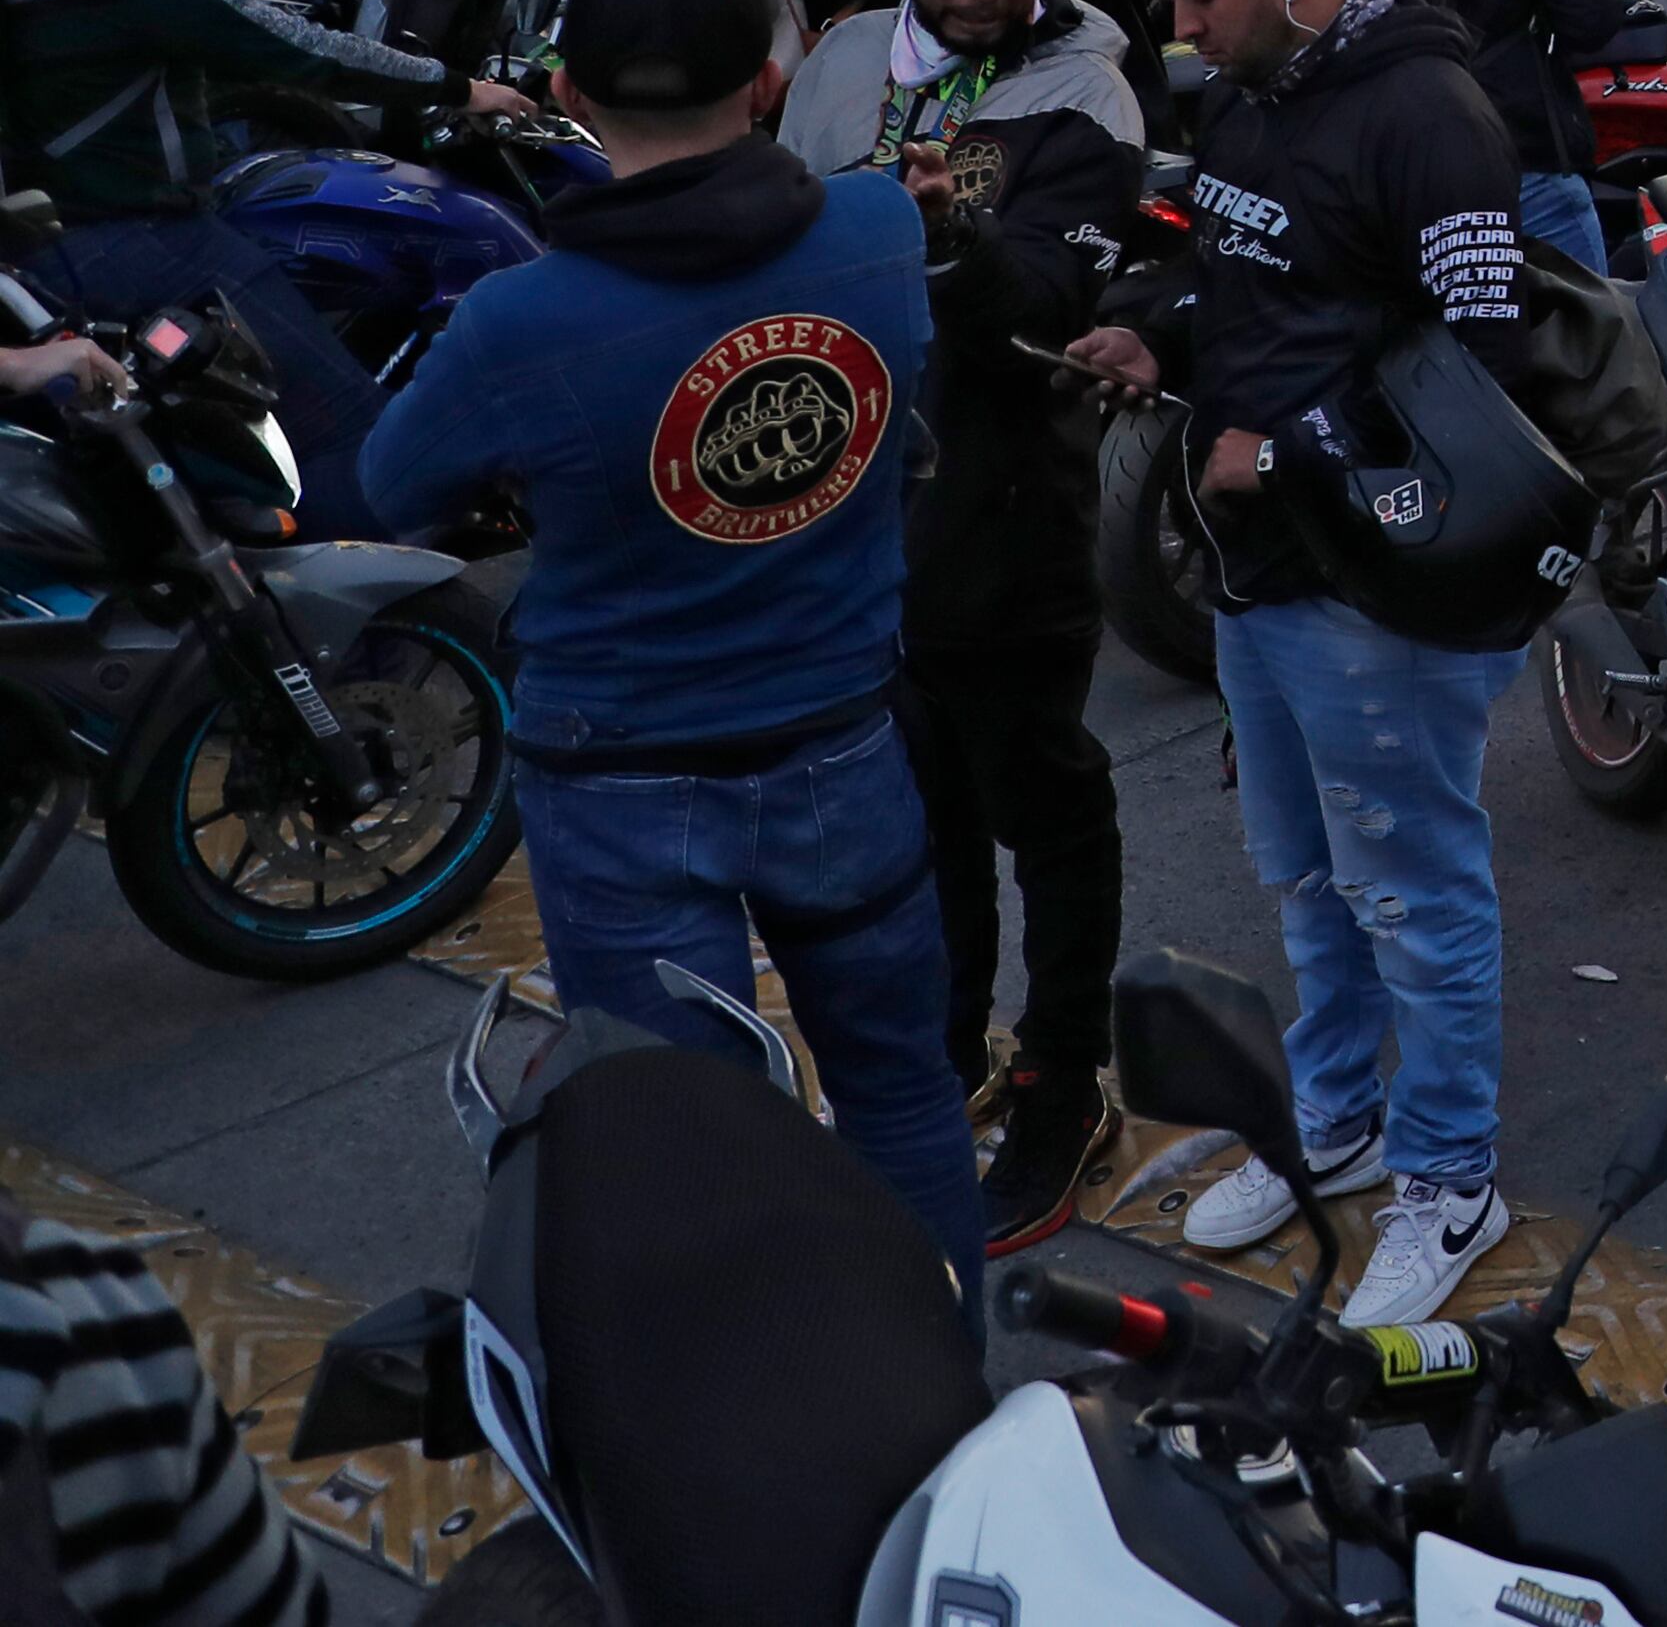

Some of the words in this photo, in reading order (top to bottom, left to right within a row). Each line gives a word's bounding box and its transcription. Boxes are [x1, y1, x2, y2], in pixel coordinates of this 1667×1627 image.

[1444, 303, 1520, 322] RMEZA
[1445, 285, 1508, 304] POYO
[687, 321, 844, 398] STREET
[694, 452, 862, 536] BROTHERS
